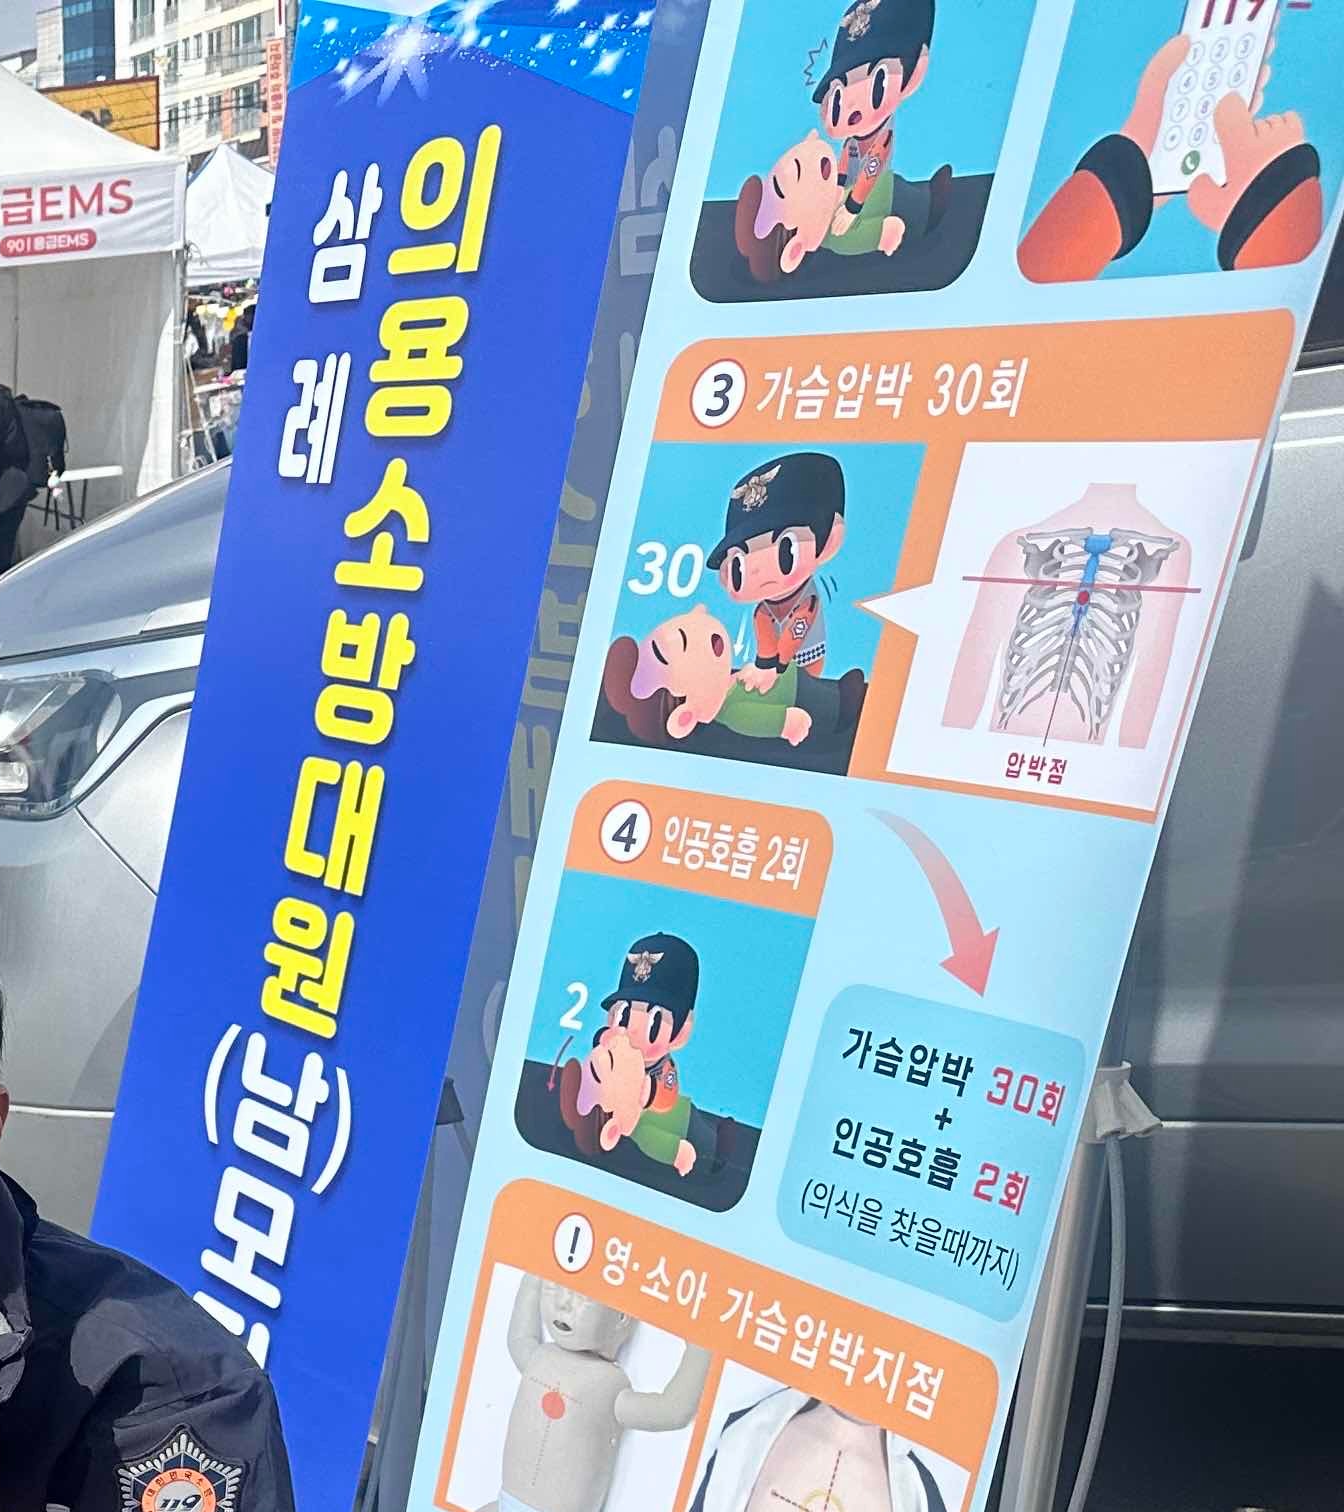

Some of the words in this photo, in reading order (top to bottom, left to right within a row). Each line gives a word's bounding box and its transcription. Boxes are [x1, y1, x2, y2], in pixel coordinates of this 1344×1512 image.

[756, 362, 912, 420] 가슴압박
[927, 357, 1029, 418] 30회
[628, 543, 703, 598] 30
[1004, 752, 1067, 785] 압박점
[661, 815, 760, 880] 인공호흡
[760, 837, 811, 890] 2회
[560, 981, 588, 1030] 2
[842, 1027, 974, 1097] 가슴압박
[986, 1066, 1065, 1126] 30회
[832, 1117, 962, 1191] 인공호흡
[973, 1162, 1030, 1216] 2회
[800, 1178, 883, 1236] (의식을
[888, 1207, 1020, 1291] 찾을때까지)
[719, 1286, 945, 1421] 가슴압박지점
[159, 1494, 202, 1511] 119
